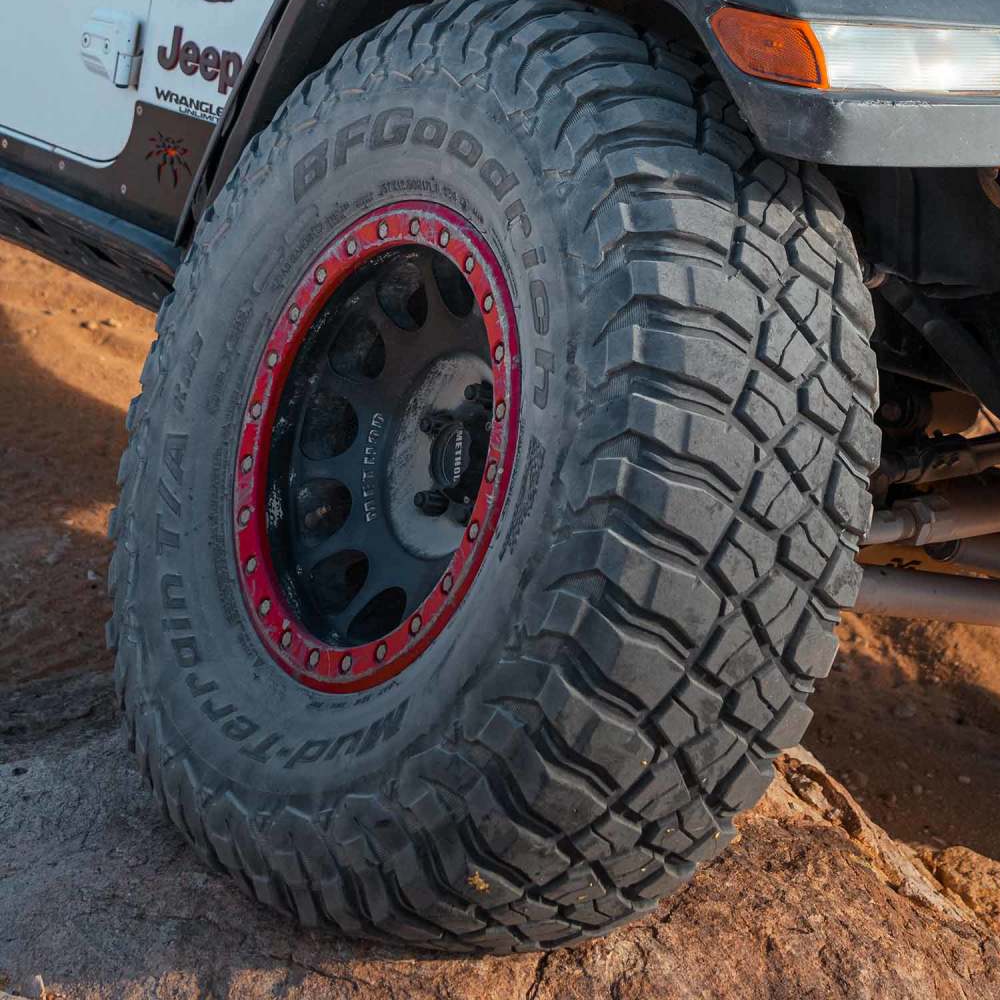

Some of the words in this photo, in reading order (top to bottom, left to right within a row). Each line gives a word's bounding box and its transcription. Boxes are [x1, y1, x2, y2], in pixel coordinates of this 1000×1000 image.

[157, 25, 243, 95] Jeep
[293, 106, 555, 410] BFGoodrich
[156, 433, 189, 557] T/A
